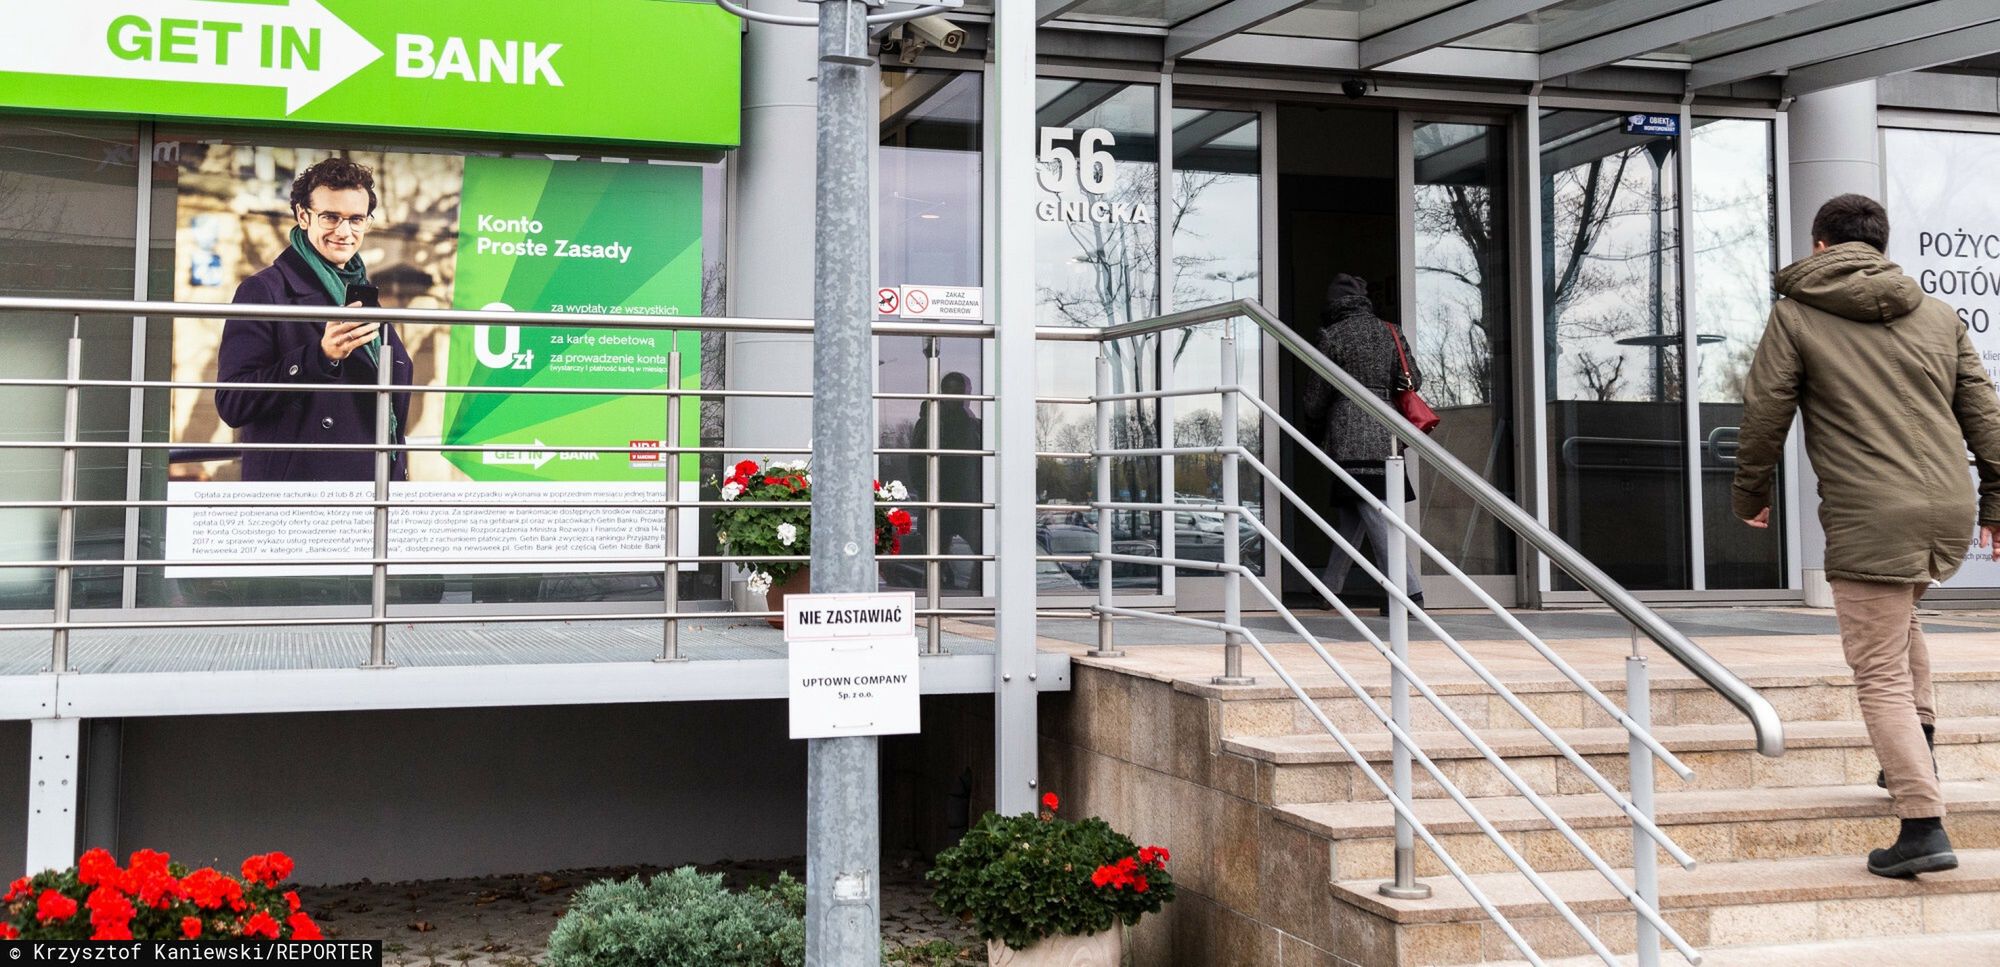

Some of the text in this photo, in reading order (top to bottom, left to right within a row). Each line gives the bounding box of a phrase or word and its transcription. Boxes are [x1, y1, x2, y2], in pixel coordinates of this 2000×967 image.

[106, 15, 564, 87] GET IN BANK
[1037, 126, 1115, 195] 56
[1036, 201, 1152, 224] GNICKA
[478, 215, 543, 234] Konto
[477, 237, 632, 263] Proste Zasady
[551, 304, 679, 315] za wypłaty ze wszystkich
[474, 302, 534, 369] 0 zł
[551, 334, 655, 347] za kartę debetową
[551, 353, 666, 365] za prowadzenie konta
[799, 605, 902, 625] NIE ZASTAWIAĆ
[802, 674, 907, 687] UPTOWN COMPANY
[838, 691, 850, 700] Sp.
